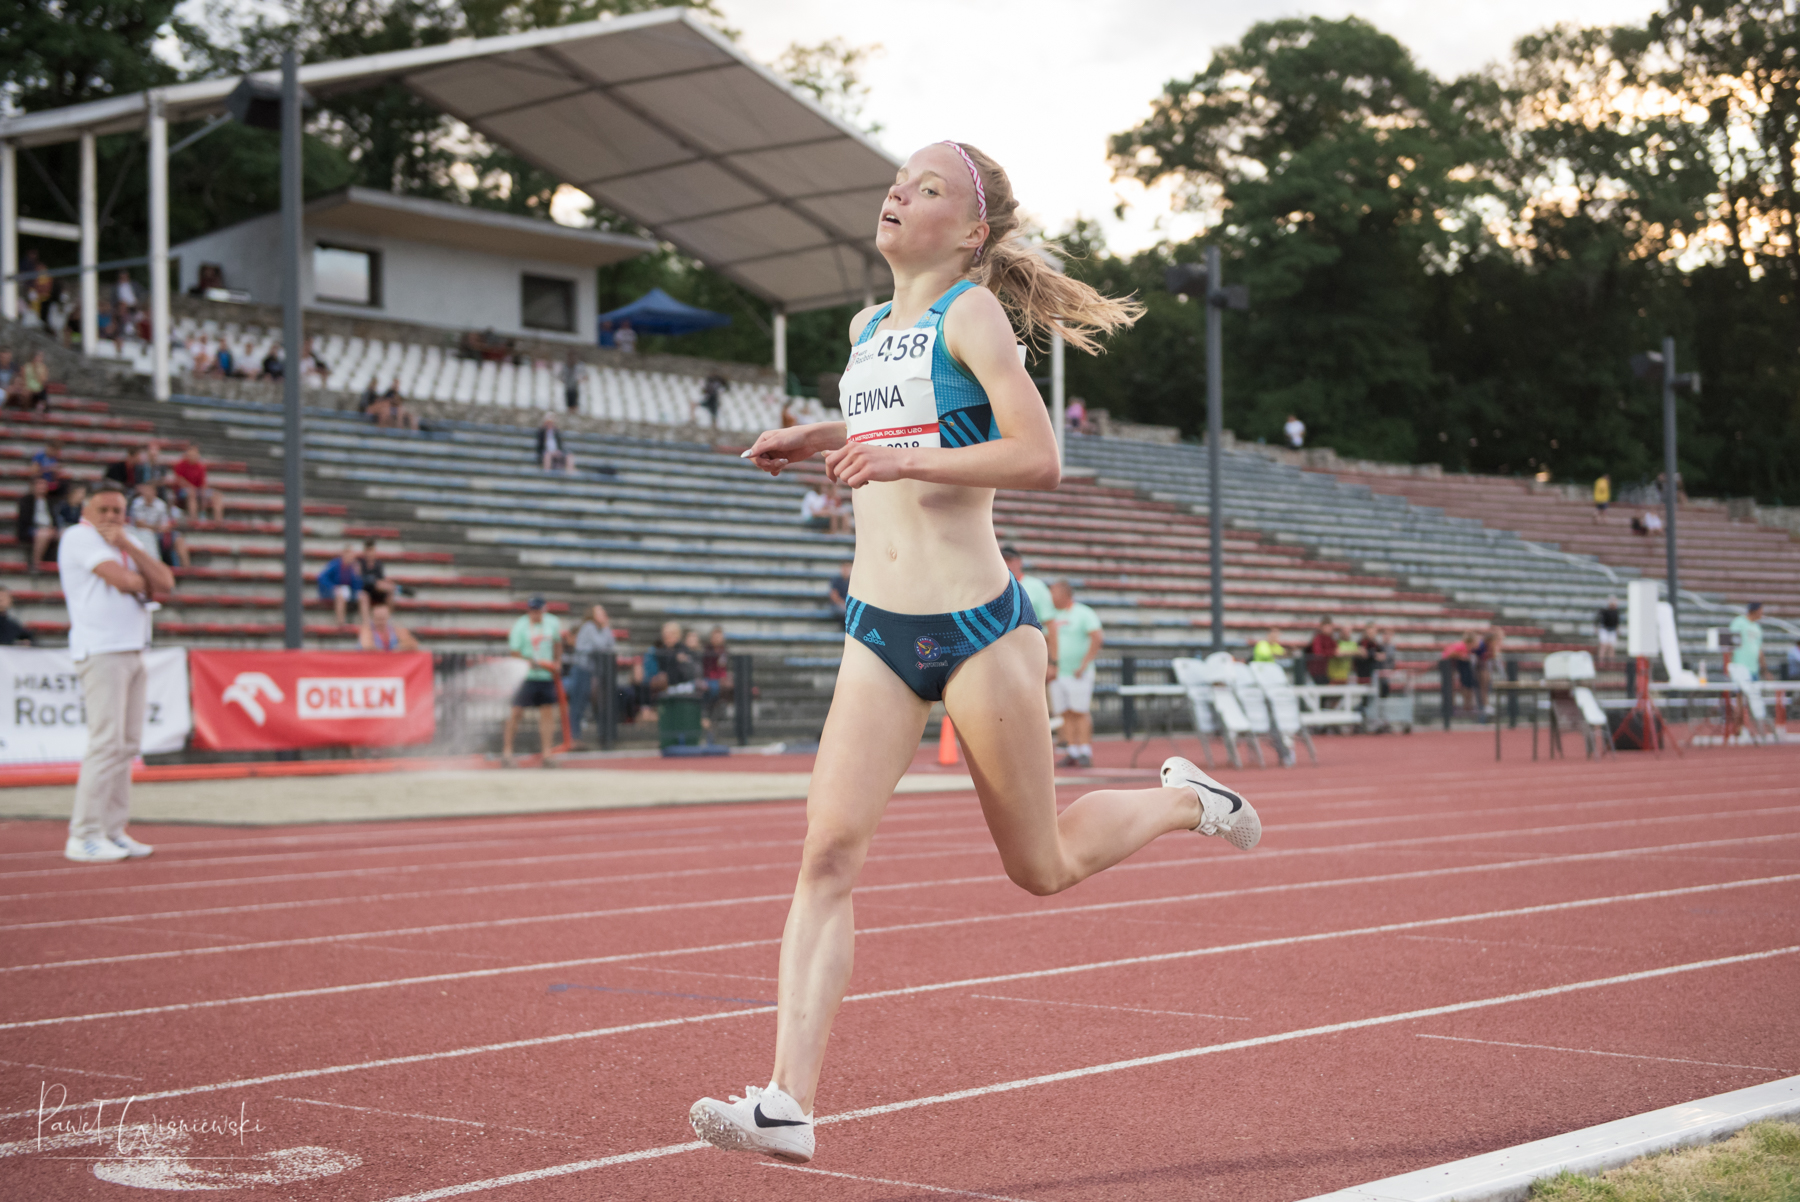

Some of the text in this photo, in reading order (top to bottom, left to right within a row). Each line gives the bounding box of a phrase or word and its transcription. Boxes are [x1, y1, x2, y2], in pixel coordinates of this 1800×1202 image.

[878, 333, 929, 362] 458
[848, 385, 905, 417] LEWNA
[862, 636, 886, 646] adidas
[15, 674, 79, 690] MIAST
[305, 685, 397, 710] ORLEN
